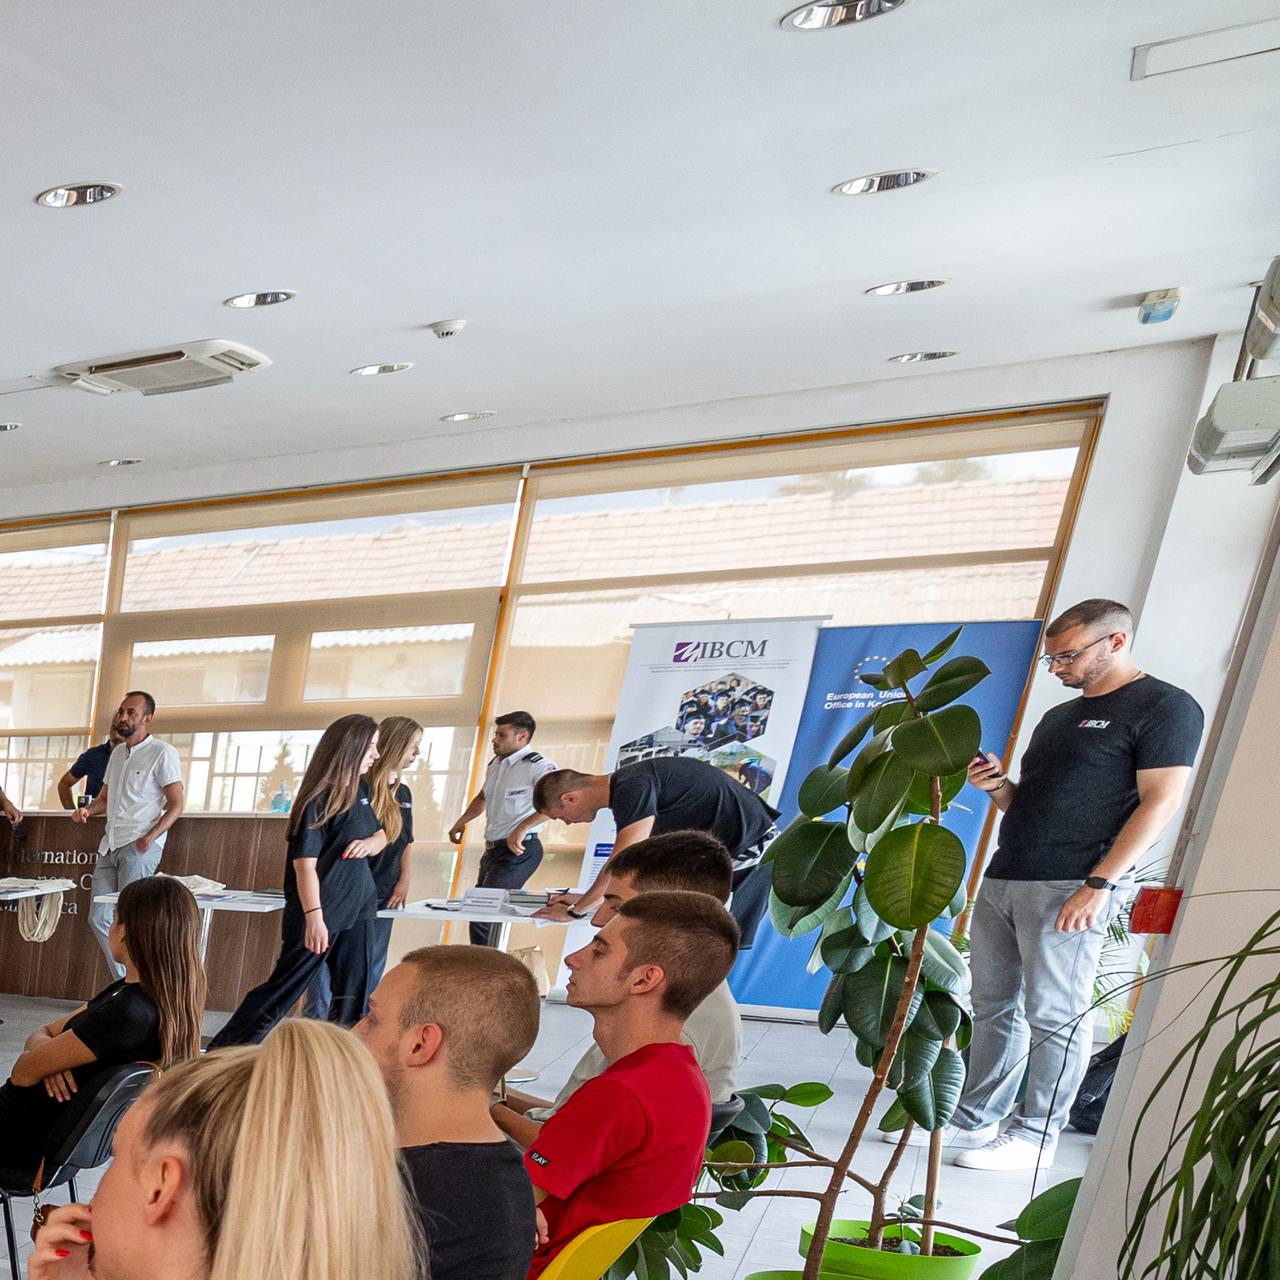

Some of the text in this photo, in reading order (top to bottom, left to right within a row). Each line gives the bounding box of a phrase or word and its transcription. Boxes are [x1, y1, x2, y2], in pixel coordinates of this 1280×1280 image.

[699, 639, 768, 660] IBCM
[826, 692, 874, 701] European
[824, 701, 853, 710] Office
[854, 701, 866, 709] in
